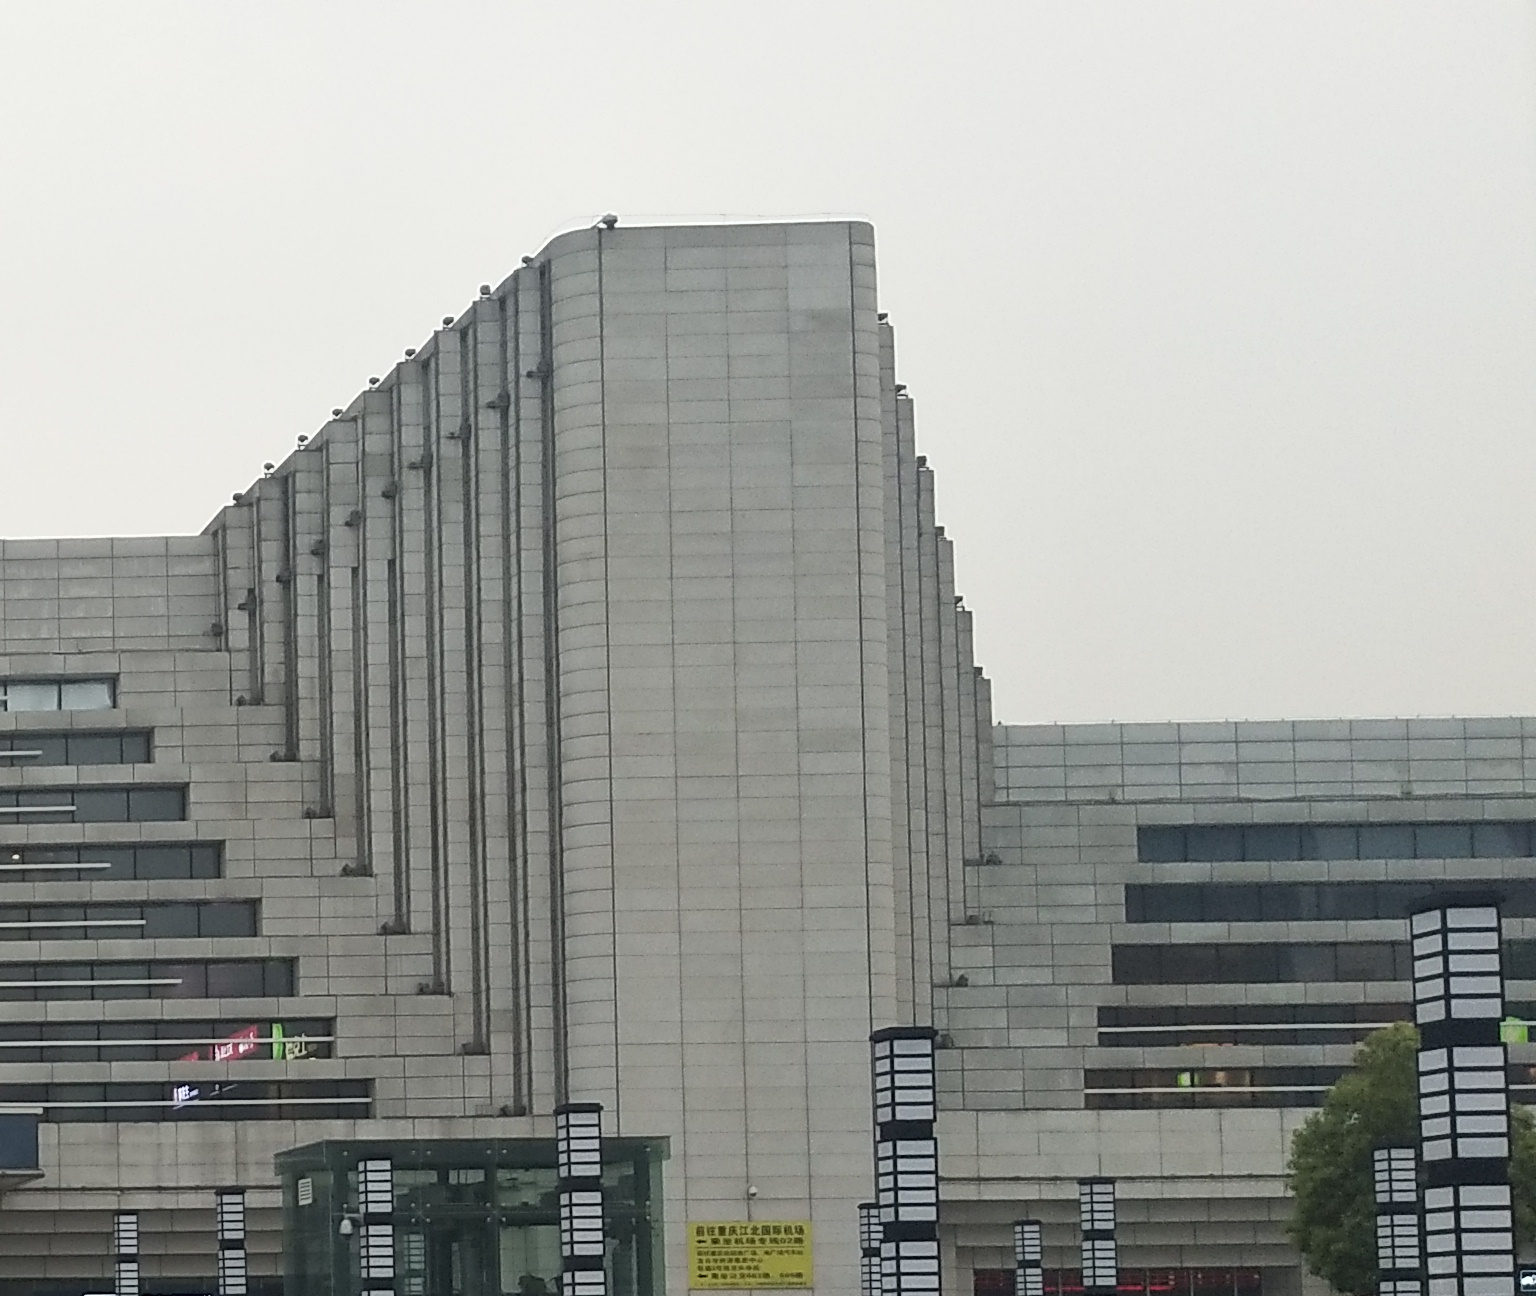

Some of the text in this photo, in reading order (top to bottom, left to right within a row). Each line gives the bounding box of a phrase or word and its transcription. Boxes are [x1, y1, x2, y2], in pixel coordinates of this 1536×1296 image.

[696, 1225, 805, 1236] 前往重庆江北国际机场
